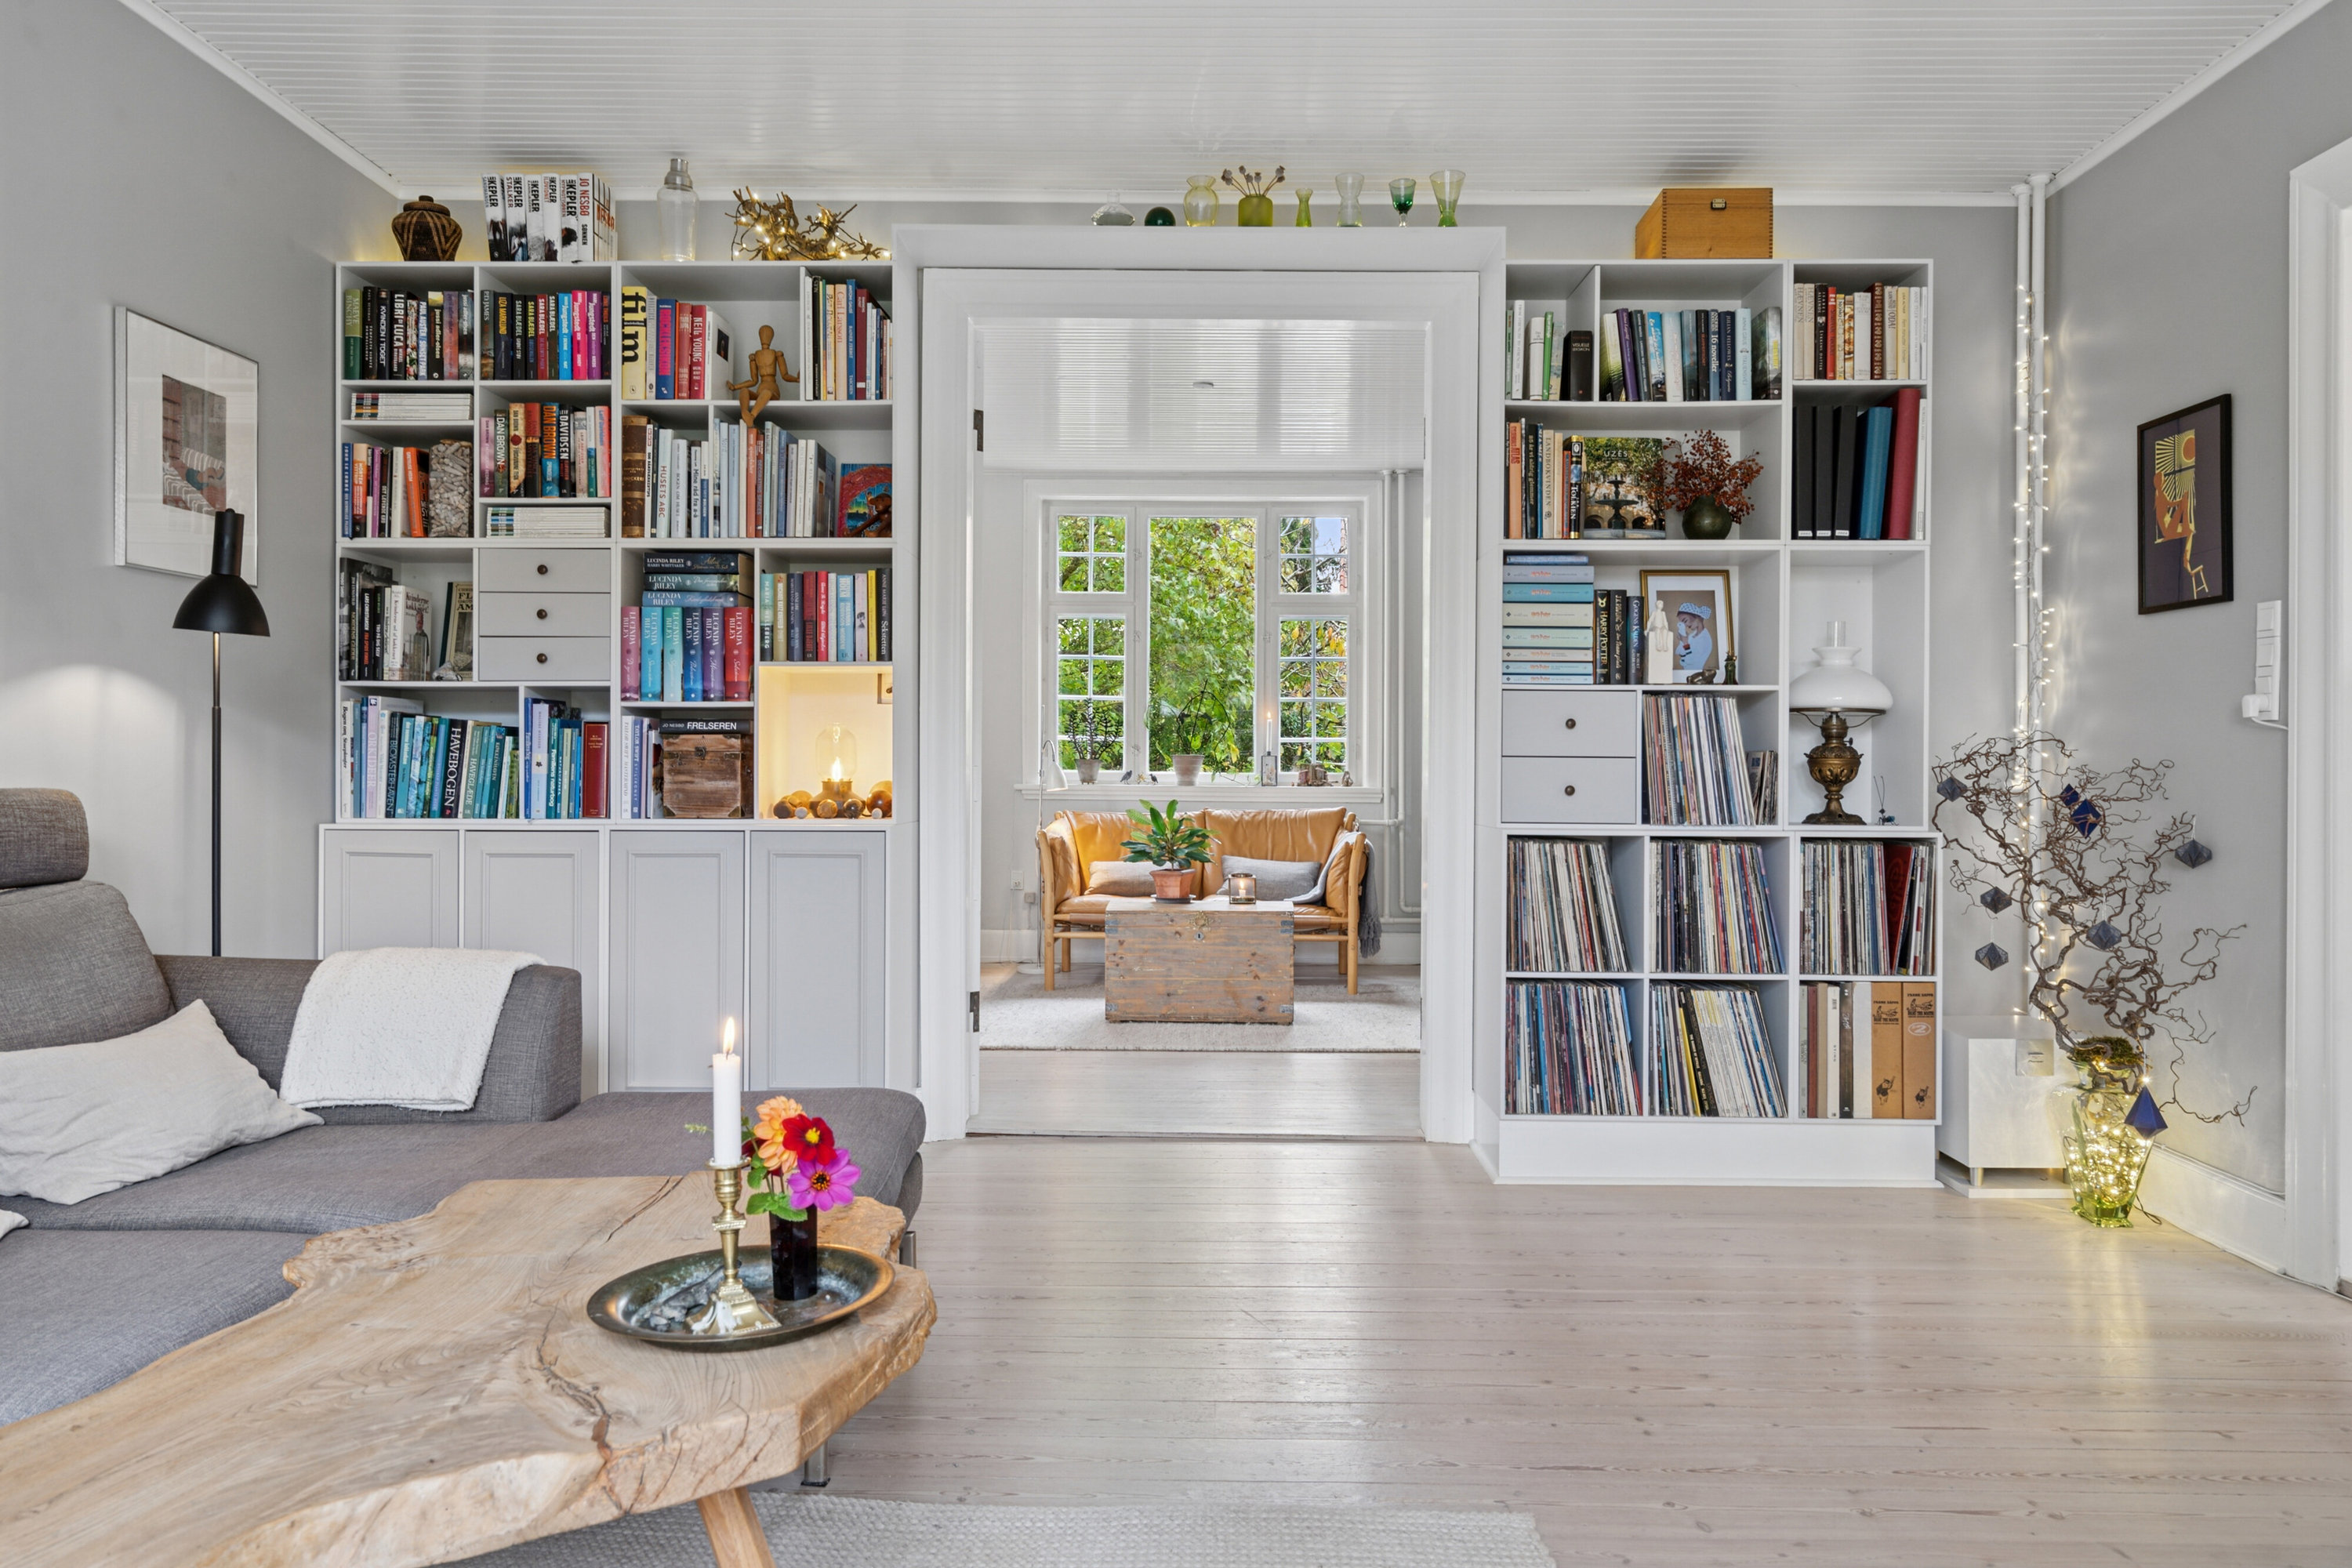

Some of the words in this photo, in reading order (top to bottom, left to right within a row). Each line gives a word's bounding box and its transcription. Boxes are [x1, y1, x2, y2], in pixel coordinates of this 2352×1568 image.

[488, 180, 499, 208] KEPLER
[514, 181, 523, 208] KEPLER
[579, 178, 590, 187] JO
[531, 184, 539, 212] KEPLER
[566, 184, 577, 216] KEPLER
[579, 190, 590, 216] NESBØ
[394, 294, 405, 318] LIBRI
[498, 297, 506, 307] LIZA
[572, 302, 581, 332] Jungstedt
[622, 292, 646, 365] film
[693, 318, 702, 335] NEIL
[394, 324, 404, 347] LUCA
[1711, 335, 1719, 343] 16
[692, 338, 702, 361] YOUNG
[496, 417, 505, 434] DAN
[543, 405, 557, 424] DAN
[496, 434, 505, 464] BROWN
[543, 426, 557, 459] BROWN
[560, 416, 569, 459] DAVIDSEN
[1511, 448, 1520, 464] ATLAS
[1599, 612, 1608, 637] HARRY
[342, 726, 347, 735] om
[368, 732, 377, 787] ORKIDEER
[444, 728, 461, 807] HAVEBOGEN
[492, 742, 501, 781] KØKKENHAVEN
[387, 740, 397, 811] BLOMSTERHAVEN
[465, 758, 477, 805] HAVEGLÆDE
[1913, 1025, 1926, 1033] 2
